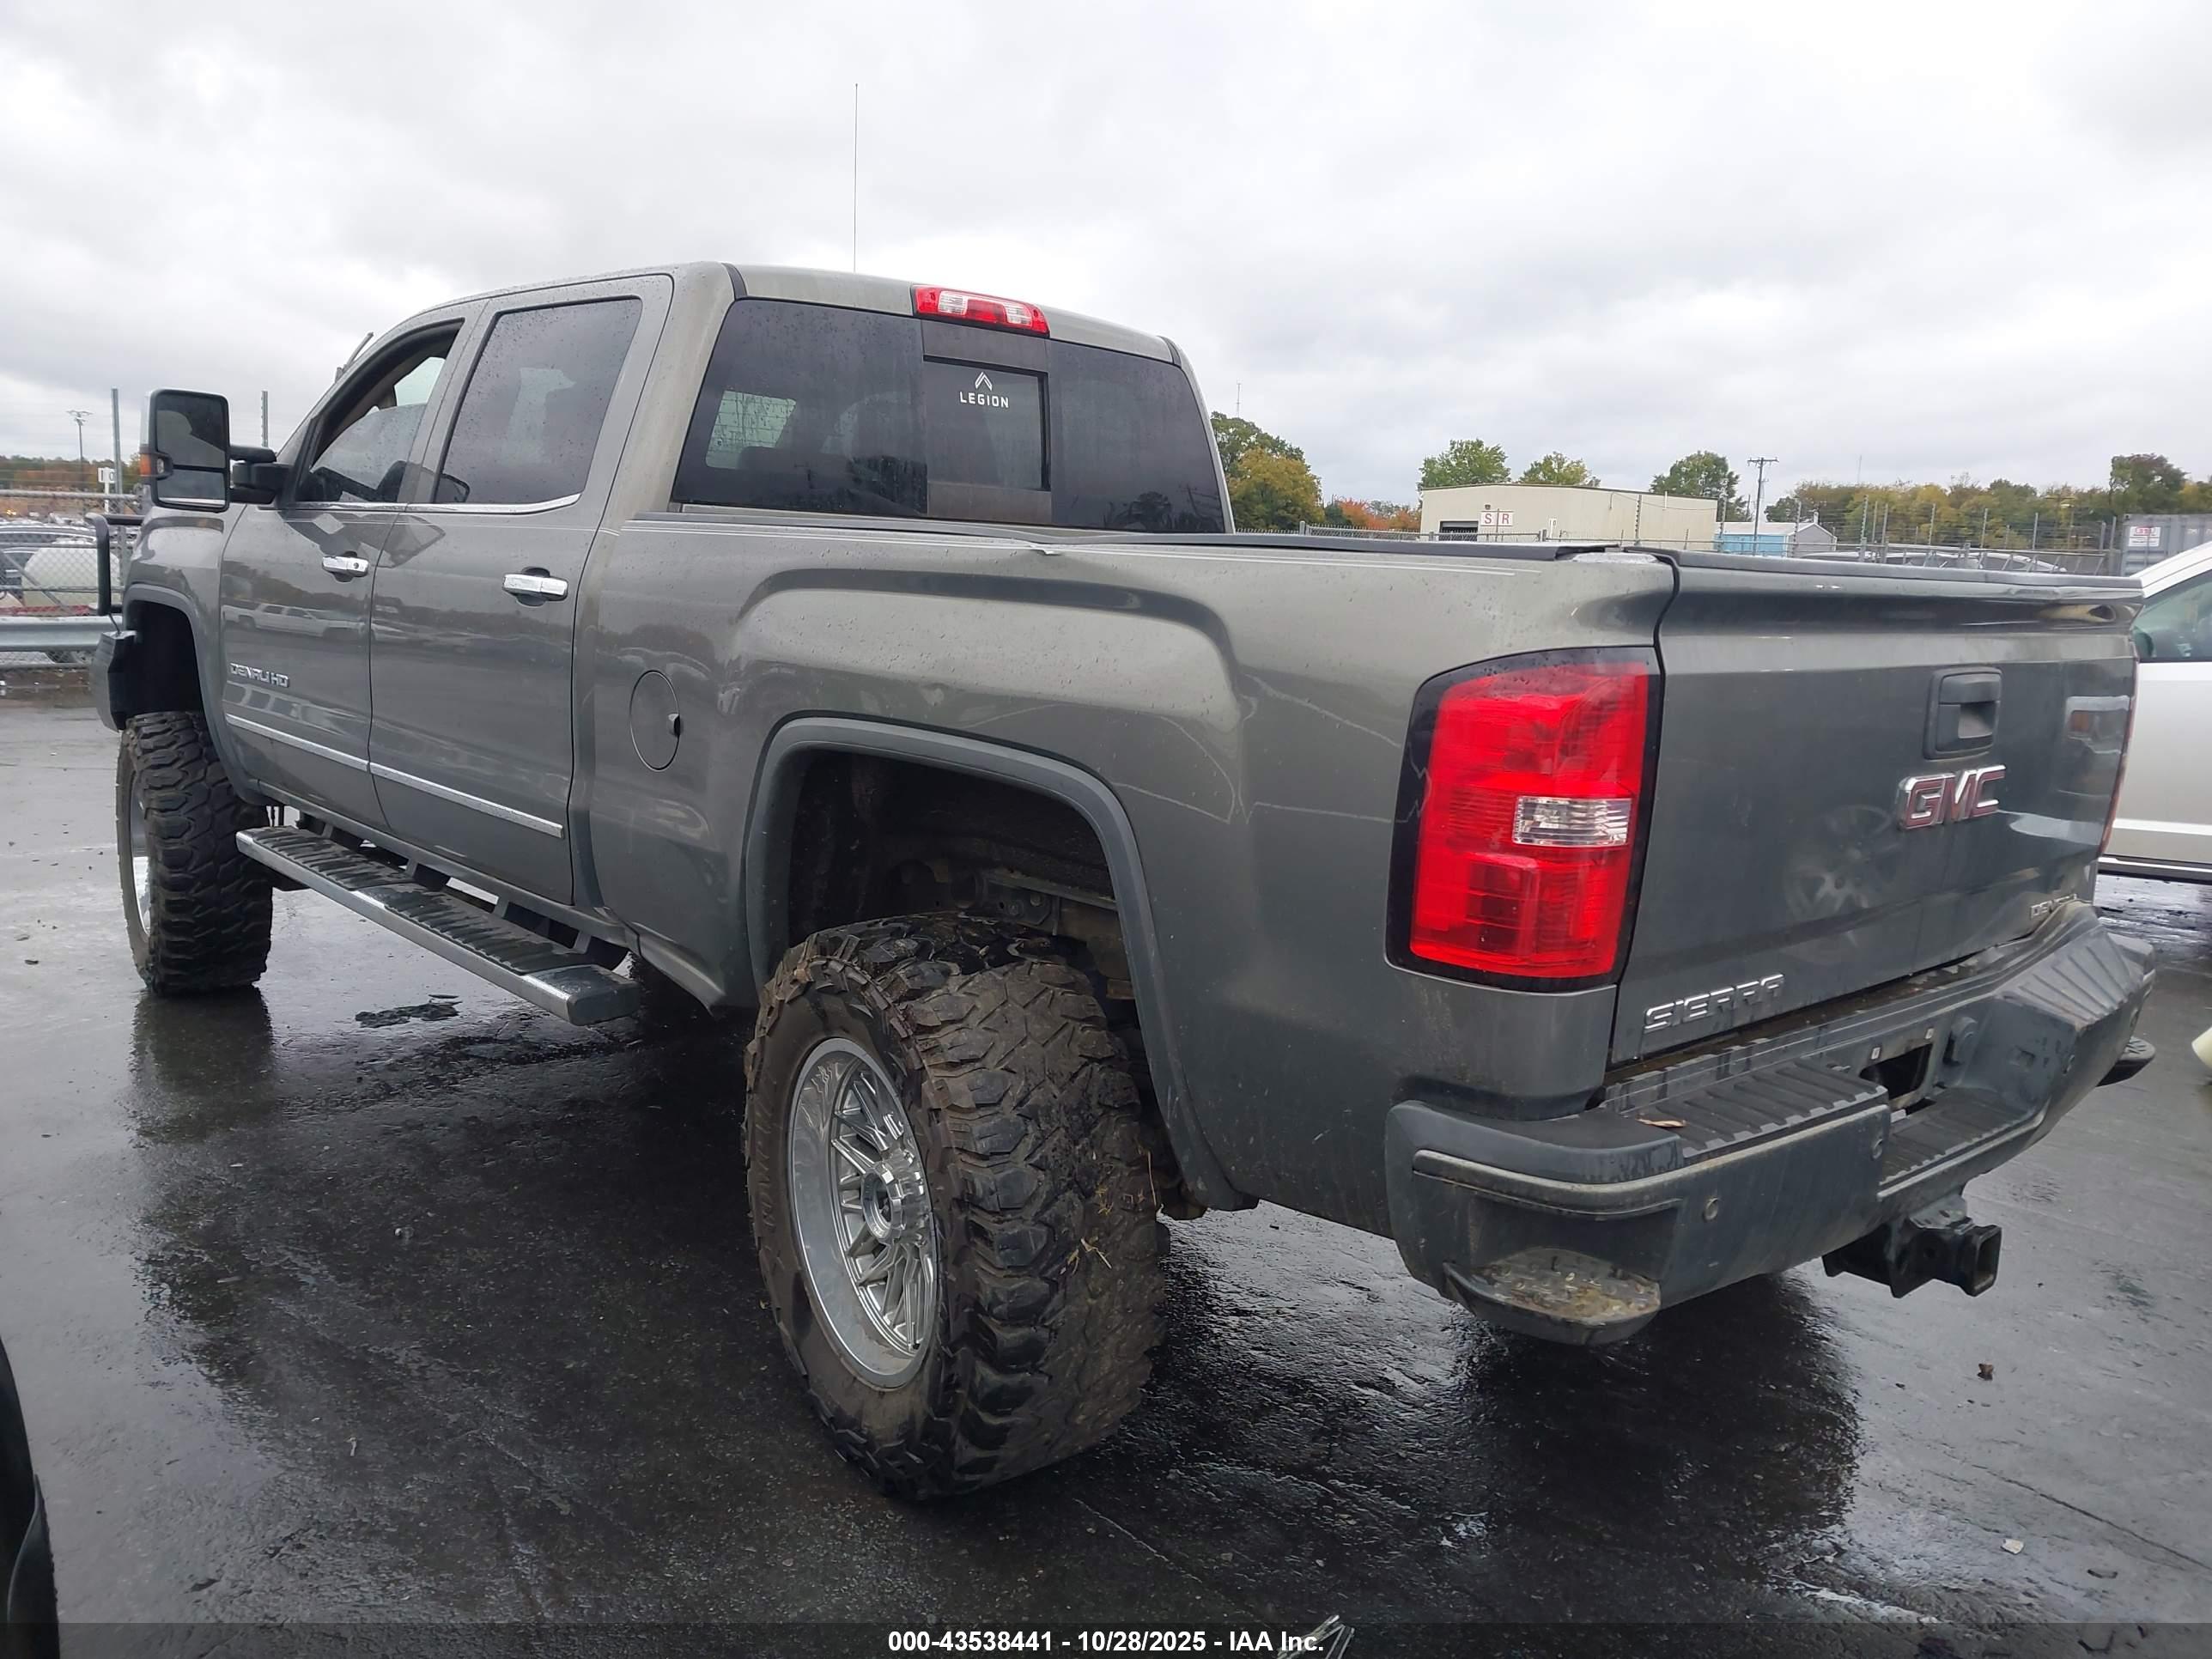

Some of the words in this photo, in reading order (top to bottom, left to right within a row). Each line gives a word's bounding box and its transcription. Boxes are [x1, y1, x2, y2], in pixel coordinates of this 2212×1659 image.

[959, 391, 1009, 408] LEGION
[229, 662, 270, 683] DENALI
[270, 672, 290, 688] HD
[1898, 764, 2006, 830] GMC
[2030, 893, 2077, 921] DENI
[1644, 973, 1785, 1034] SIERRA
